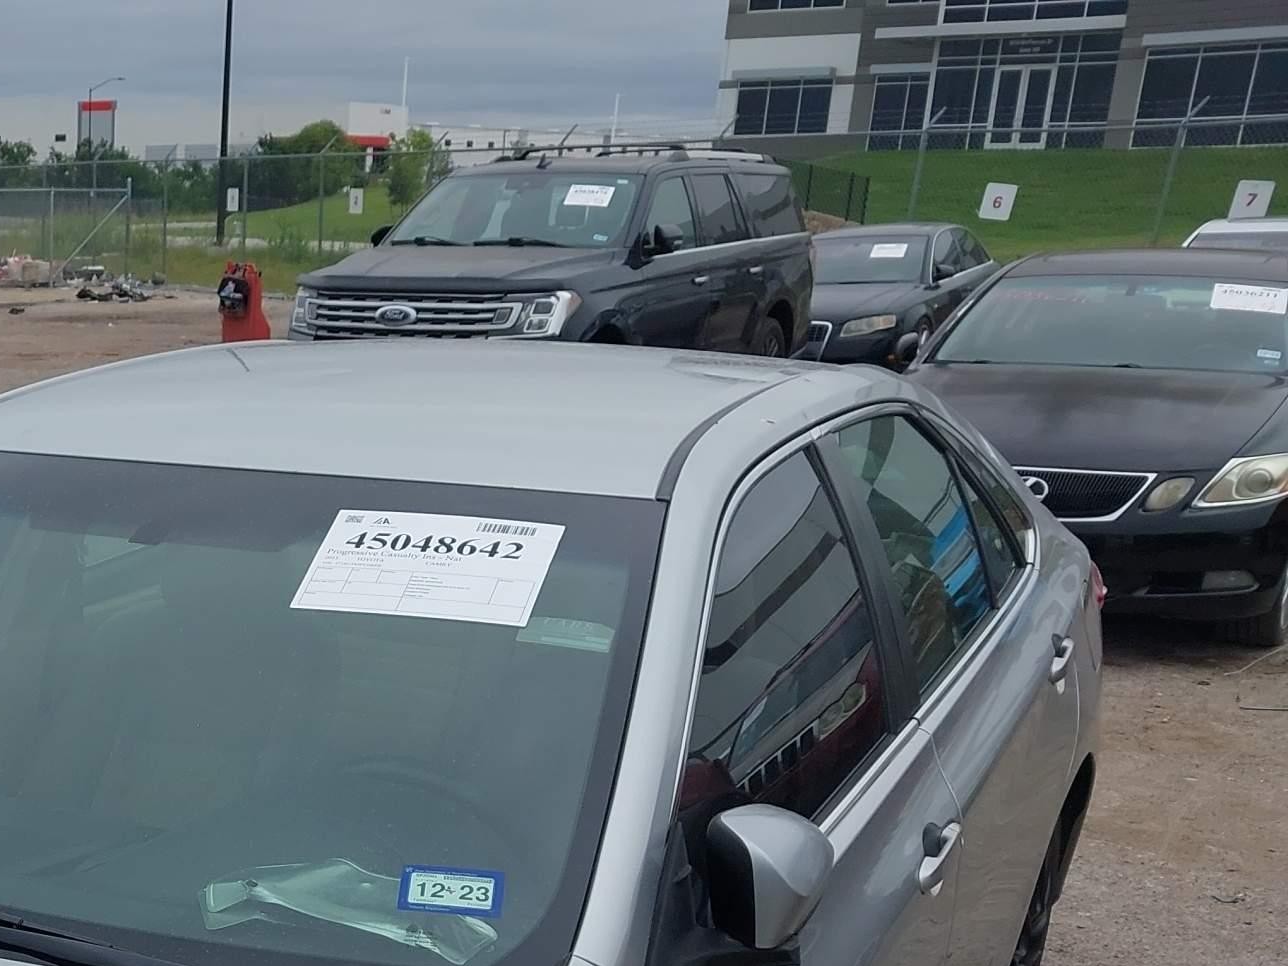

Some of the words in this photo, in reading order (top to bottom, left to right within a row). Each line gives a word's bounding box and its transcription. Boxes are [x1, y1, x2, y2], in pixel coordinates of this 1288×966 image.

[993, 196, 1003, 208] 6
[1246, 192, 1258, 207] 7
[345, 531, 524, 560] 45048642
[327, 547, 379, 557] Progressive
[380, 551, 418, 560] Casualty
